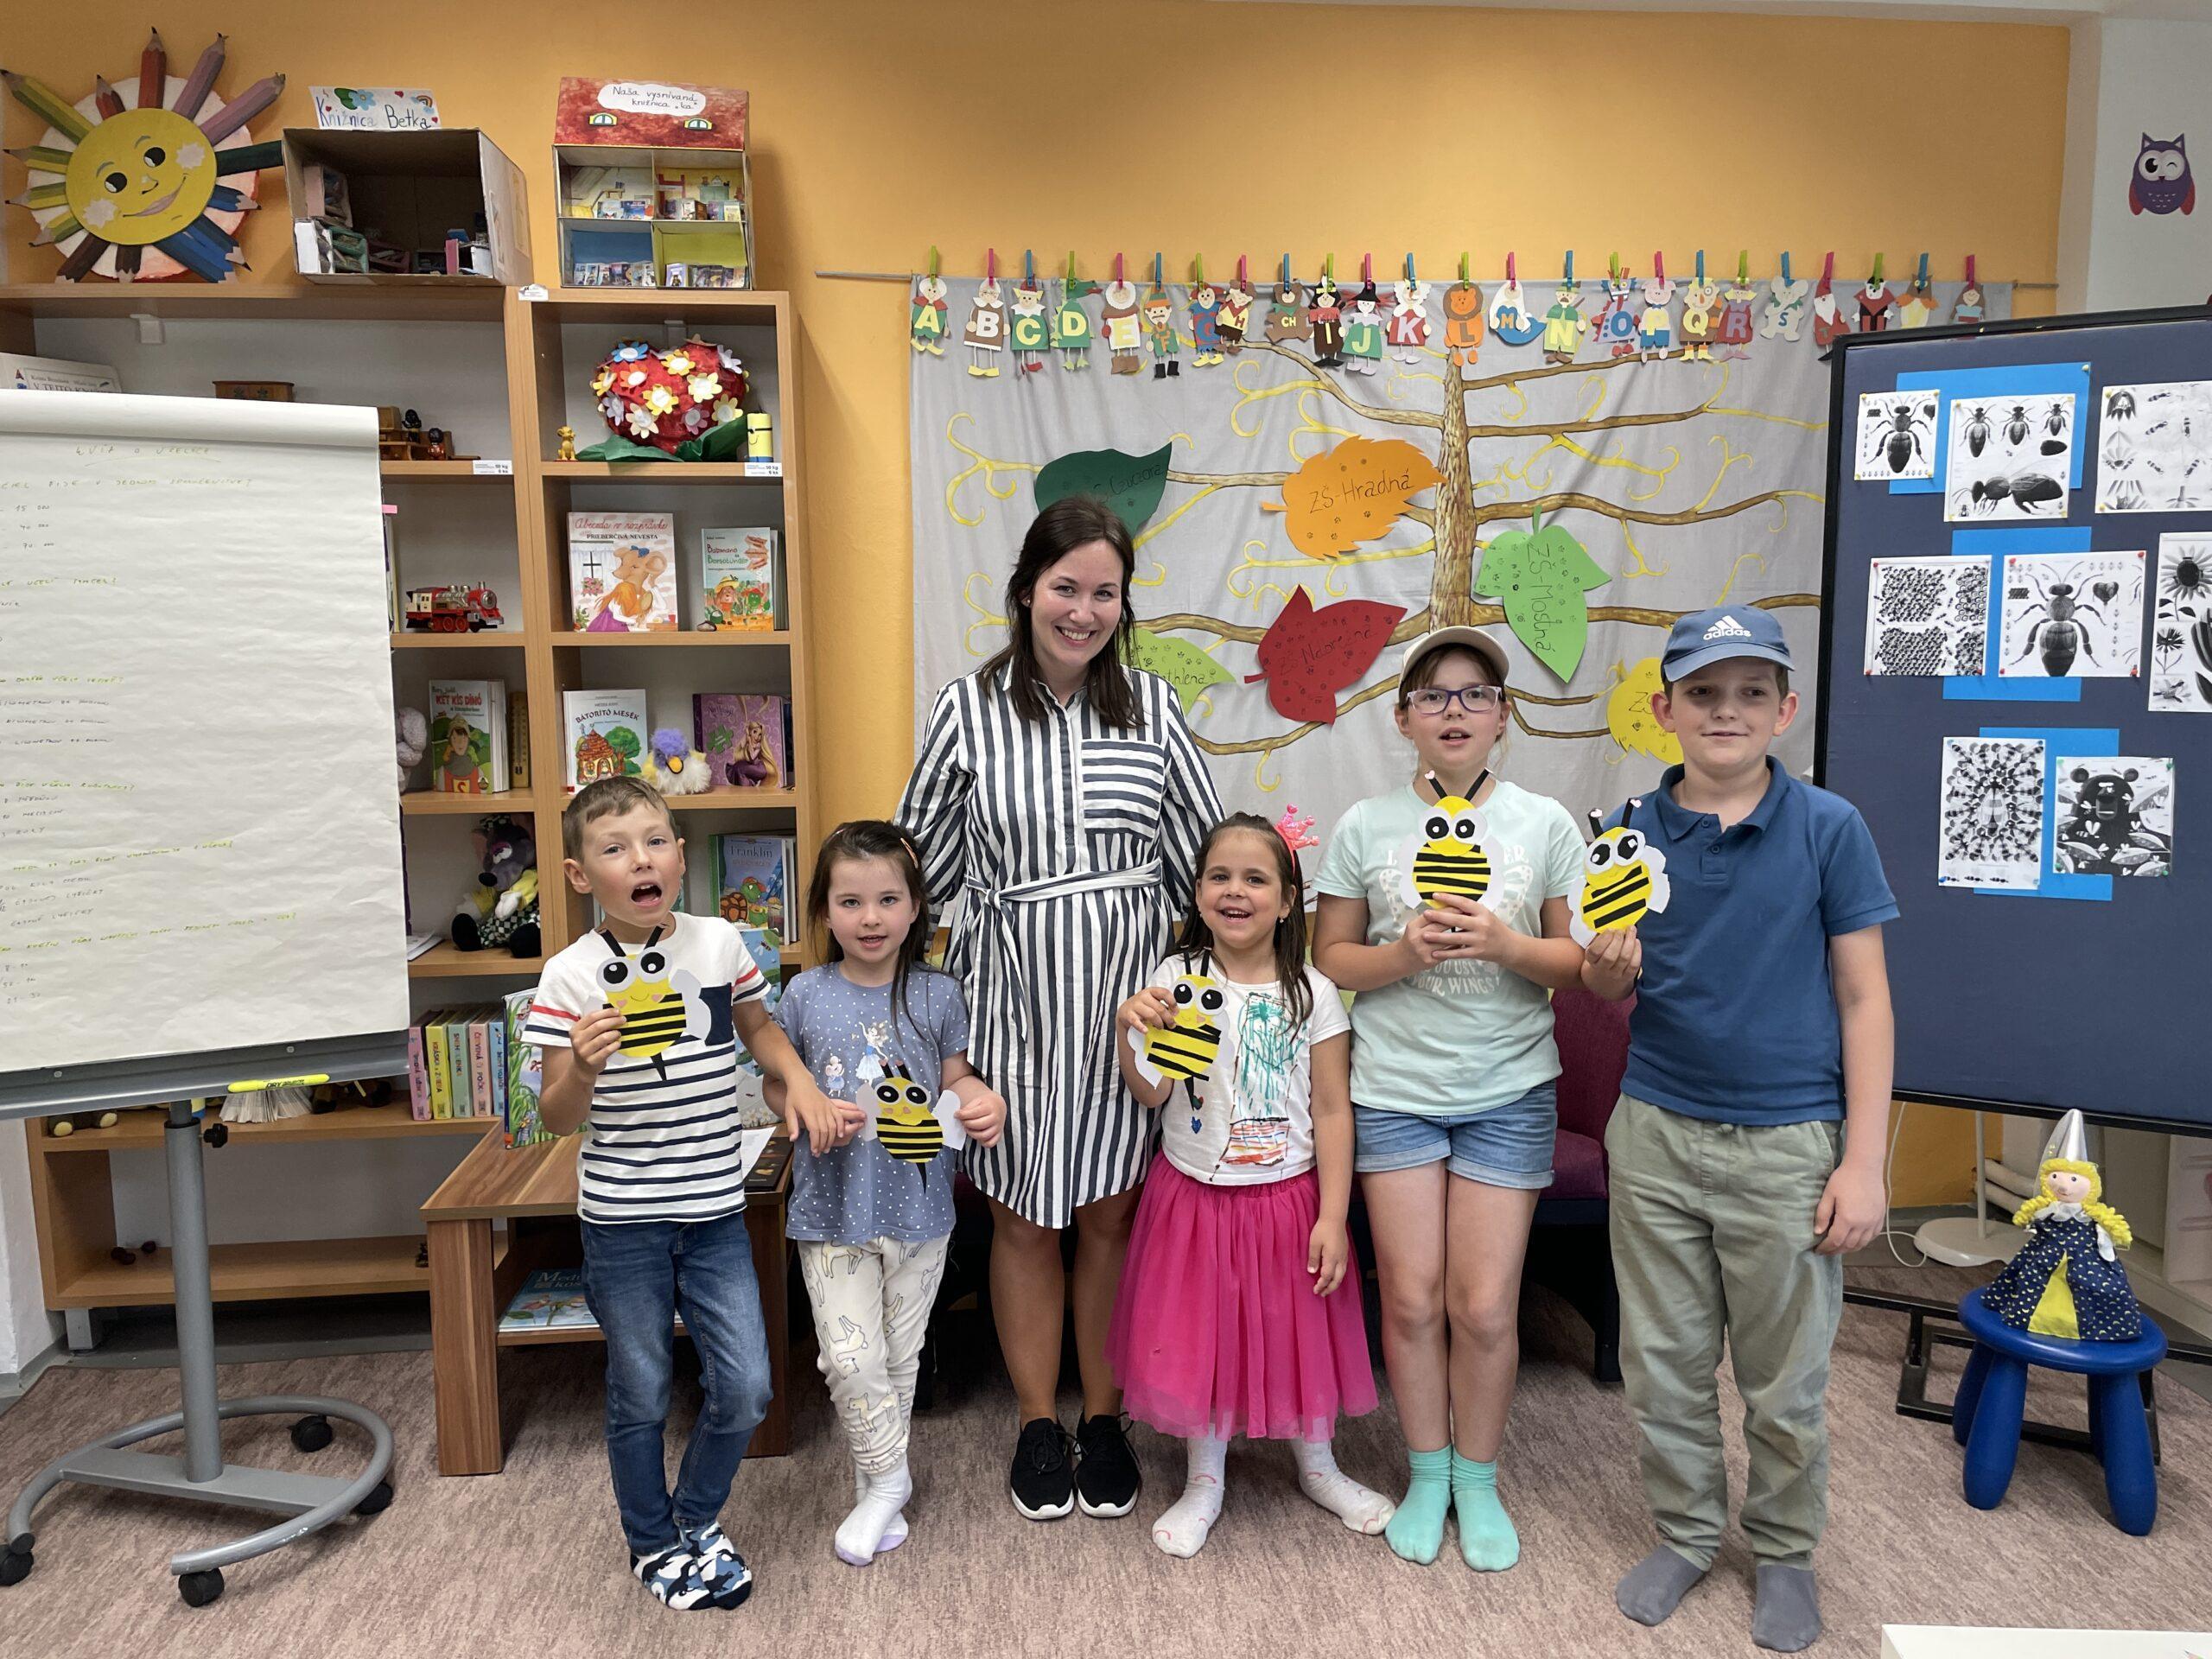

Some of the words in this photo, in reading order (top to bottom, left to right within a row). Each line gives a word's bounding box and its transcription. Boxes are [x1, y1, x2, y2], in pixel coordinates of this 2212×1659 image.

[613, 86, 639, 96] Naša
[316, 96, 378, 127] Knižnica
[385, 105, 431, 129] Betka
[914, 304, 940, 334] A
[976, 310, 1000, 337] B
[1016, 318, 1041, 345] C
[1063, 311, 1086, 336] D
[1114, 319, 1135, 345] E
[1235, 315, 1246, 328] H
[1281, 316, 1296, 327] CH
[1325, 322, 1332, 344] I
[1351, 327, 1371, 353] J
[1397, 316, 1420, 344] K
[1460, 322, 1475, 343] L
[1501, 313, 1515, 329] M
[1549, 321, 1575, 346] N
[1611, 310, 1634, 337] O
[1646, 312, 1668, 335] P
[1683, 307, 1708, 336] Q
[1726, 312, 1748, 338] R
[1778, 312, 1789, 327] S
[1703, 628, 1752, 640] adidas
[613, 709, 639, 721] MESÉK
[731, 846, 772, 858] Franklin
